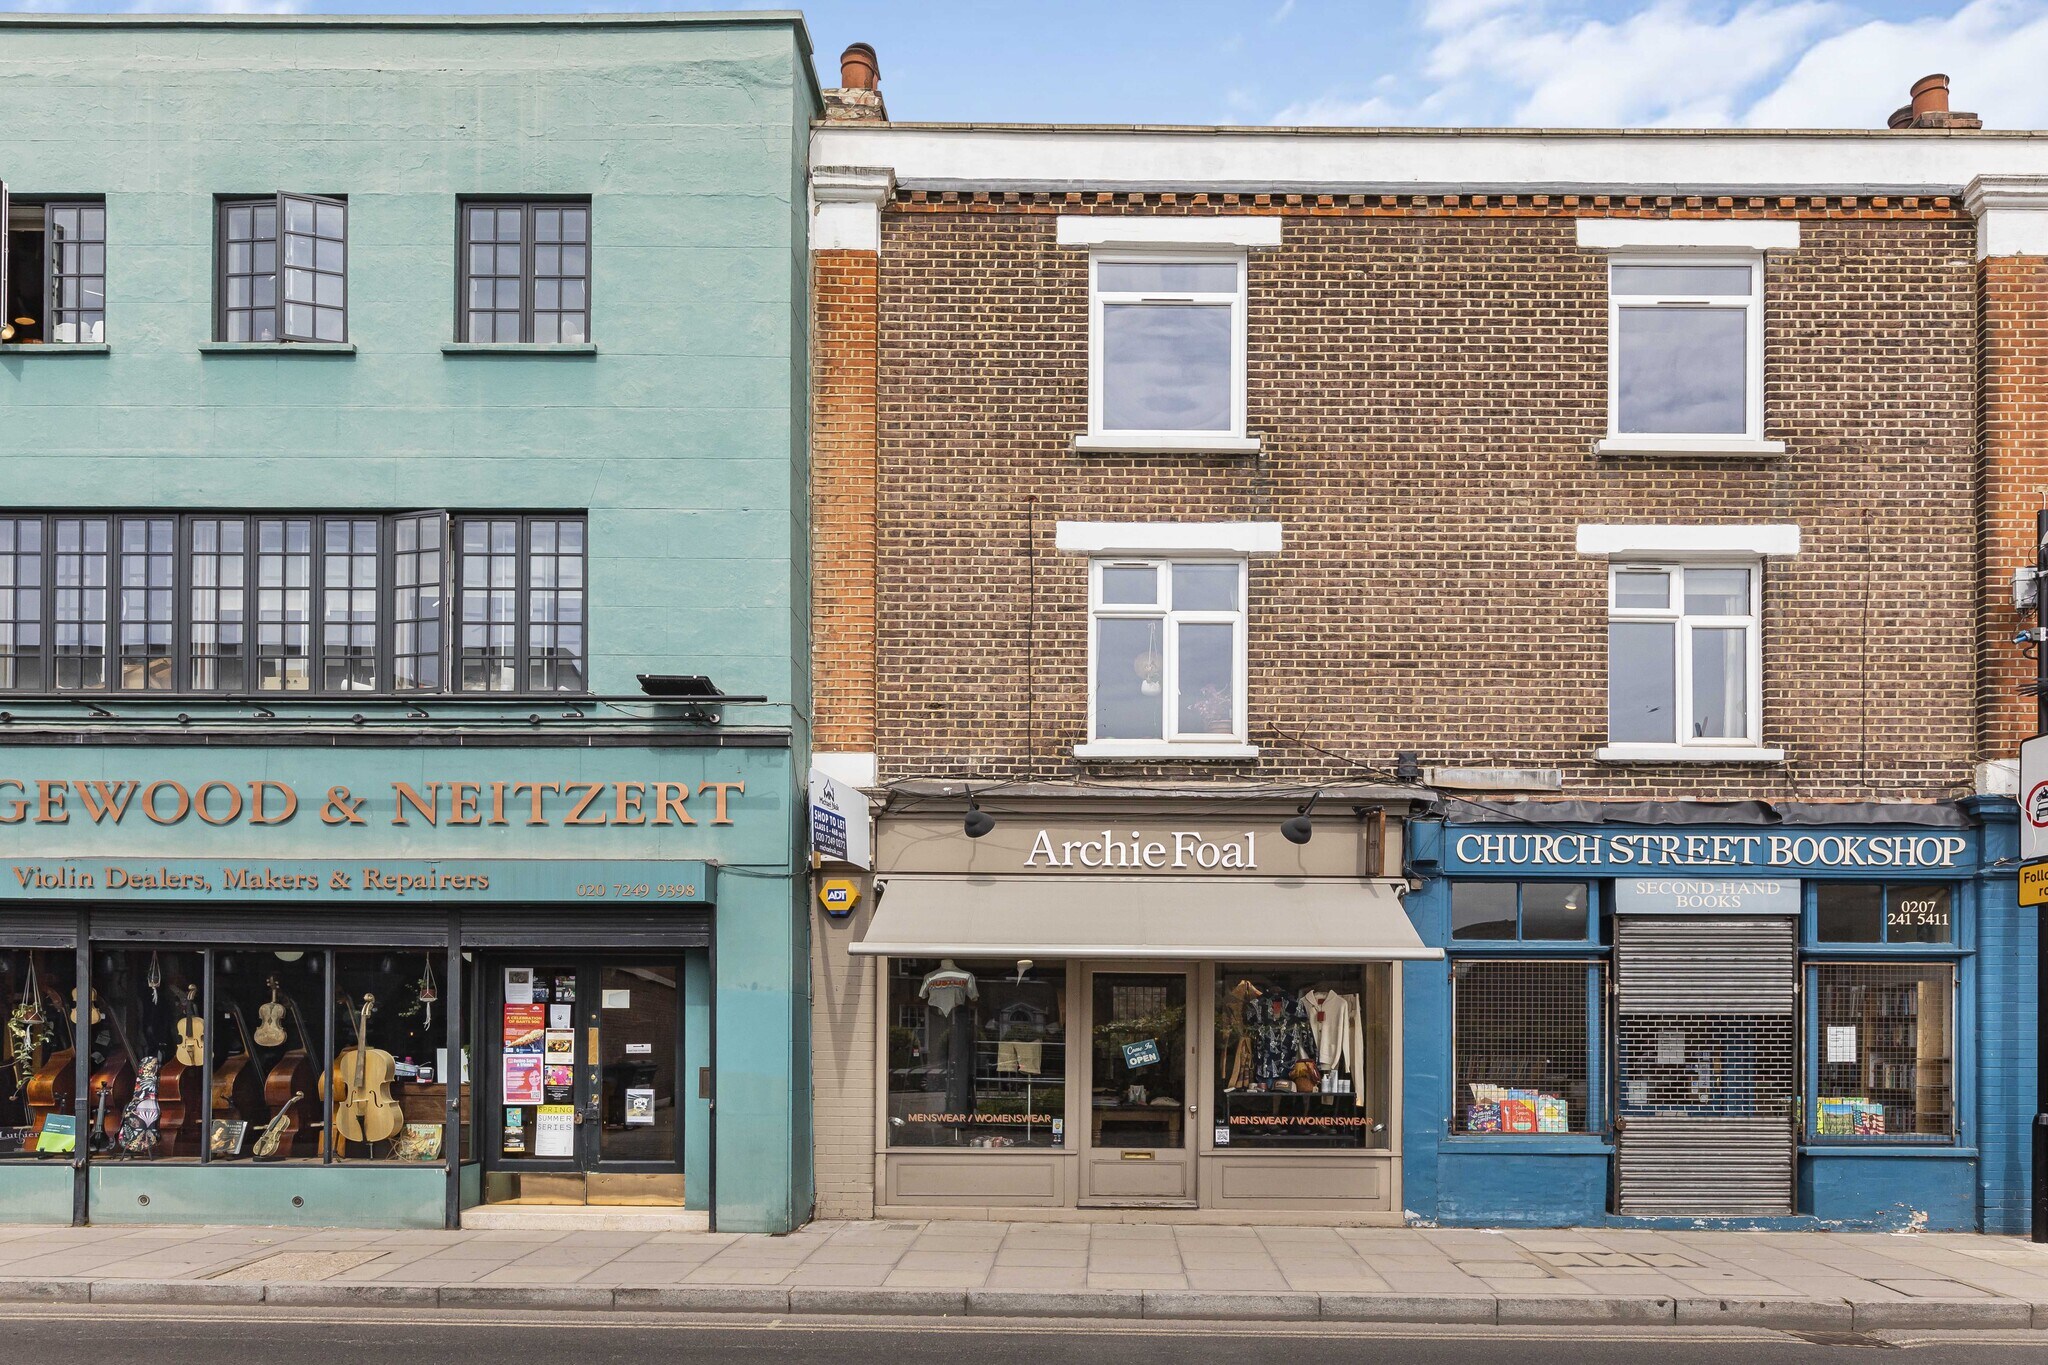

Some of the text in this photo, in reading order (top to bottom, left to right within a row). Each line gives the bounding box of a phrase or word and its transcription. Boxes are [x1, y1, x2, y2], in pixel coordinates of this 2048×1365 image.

[320, 785, 367, 824] &
[391, 780, 745, 826] NEITZERT
[814, 810, 845, 830] SHOP TO LET
[815, 832, 825, 843] 020
[1023, 829, 1258, 868] Archie Foal
[1456, 834, 1966, 867] CHURCH STREET BOOKSHOP
[12, 866, 490, 895] Violin Dealers, Makers & Repairers
[576, 882, 696, 898] 020 7249 9398
[1636, 882, 1781, 895] SECOND-HAND
[828, 890, 847, 901] ADT
[1676, 895, 1742, 908] BOOKS
[1901, 900, 1937, 913] 0207
[1887, 913, 1949, 926] 241 5411
[1126, 1042, 1153, 1055] Come In
[1129, 1053, 1157, 1065] OPEN
[908, 1113, 966, 1123] MENSWEAR
[967, 1114, 973, 1123] /
[974, 1114, 1051, 1124] WOMENSWEAR
[1229, 1115, 1374, 1126] MENSWEAR / WOMENSWEAR
[537, 1123, 572, 1131] SERIES
